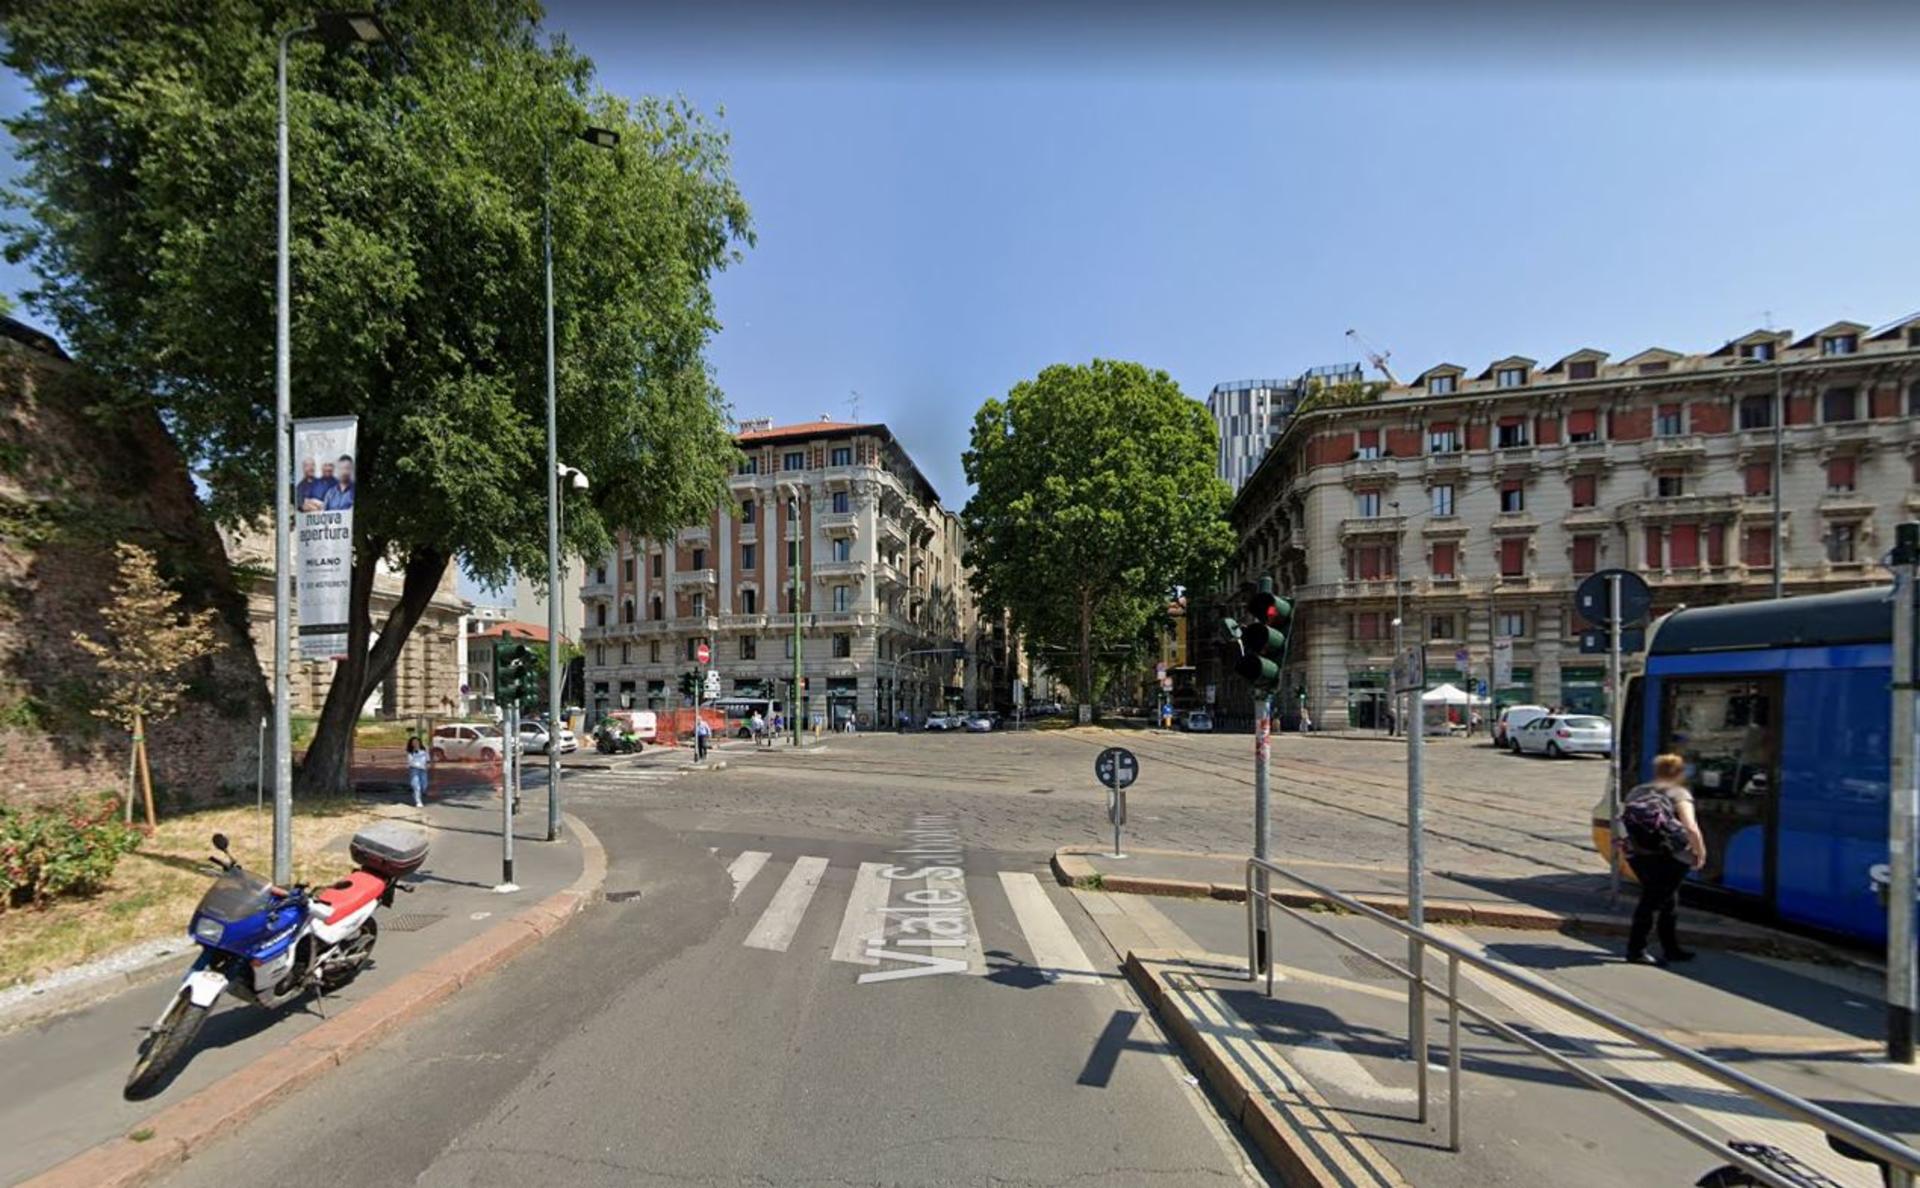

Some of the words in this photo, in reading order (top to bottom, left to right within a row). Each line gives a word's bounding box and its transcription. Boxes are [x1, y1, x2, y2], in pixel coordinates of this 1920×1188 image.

[306, 512, 341, 526] nuova
[300, 525, 349, 547] apertura
[306, 557, 341, 567] MILANO
